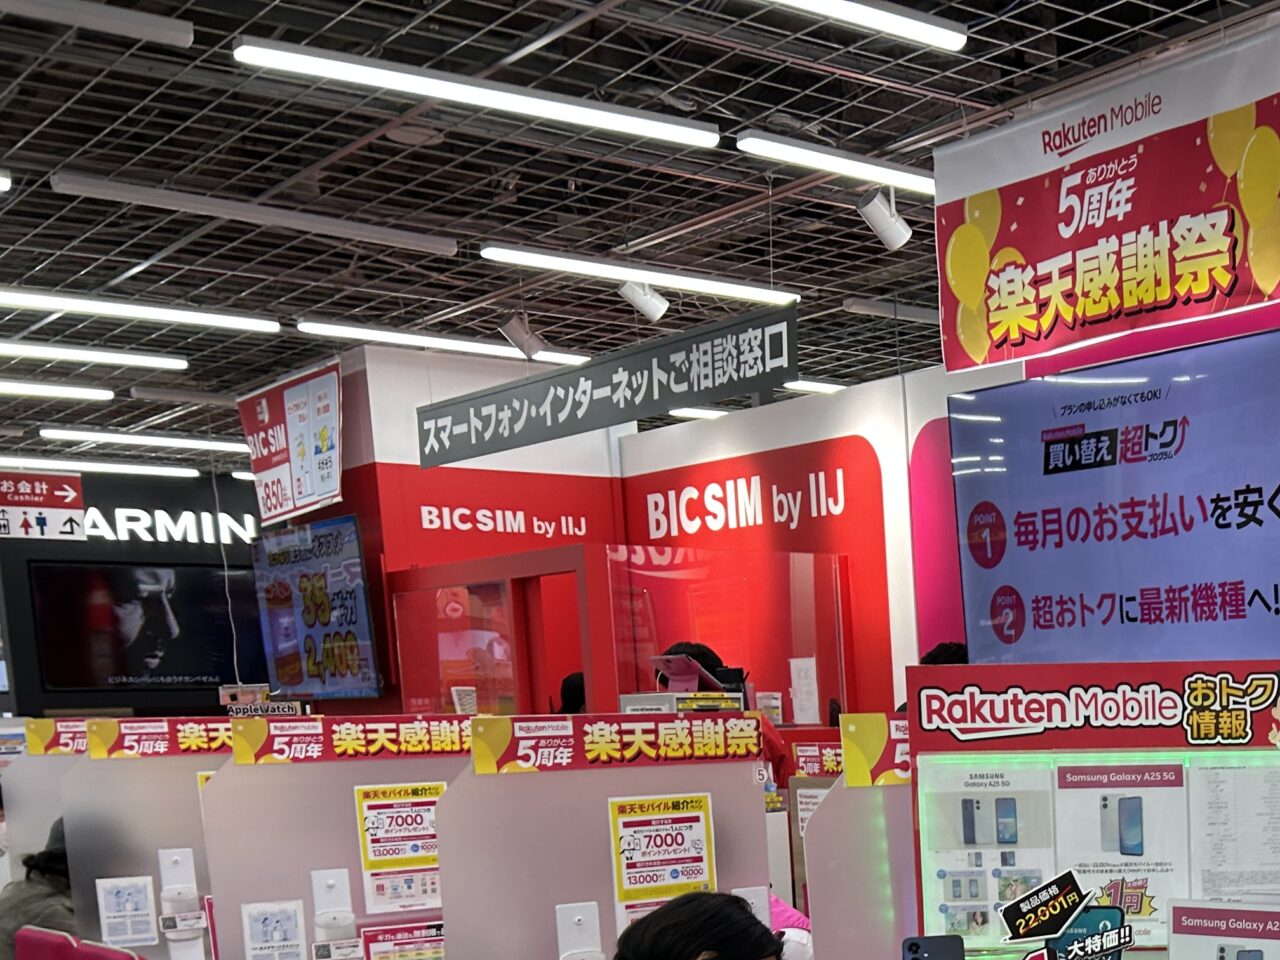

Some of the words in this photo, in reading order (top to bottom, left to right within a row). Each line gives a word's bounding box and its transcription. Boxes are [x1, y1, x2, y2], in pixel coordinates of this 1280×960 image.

[1042, 113, 1107, 157] Rakuten
[1110, 93, 1163, 132] Mobile
[1085, 155, 1138, 184] ありがとう
[1057, 170, 1137, 239] 5周年
[987, 210, 1234, 342] 楽天感謝祭
[423, 320, 790, 456] スマートフォン・インターネットご相談窓口
[1048, 434, 1114, 470] 買い替え
[0, 480, 48, 495] お会計
[7, 493, 44, 502] Cashier
[772, 484, 802, 529] by
[809, 468, 846, 518] IIJ
[533, 516, 557, 538] by
[561, 516, 587, 536] IIJ
[973, 513, 997, 525] POINT
[981, 529, 993, 559] 1
[1031, 580, 1280, 631] 超おトクに最新機種へ!
[1001, 607, 1016, 636] 2
[1187, 675, 1276, 708] おトク
[925, 686, 1067, 738] Rakuten
[1074, 684, 1181, 727] Mobile
[1187, 709, 1250, 742] 情報
[332, 720, 472, 756] 楽天感謝
[518, 723, 545, 736] Rakuten
[583, 718, 760, 761] 楽天感謝祭
[123, 735, 169, 755] 5周年
[272, 736, 323, 760] 5周年
[517, 739, 574, 768] 5周年
[964, 781, 988, 789] Galaxy
[1066, 773, 1108, 783] Samsung
[1110, 773, 1142, 782] Galaxy
[1143, 772, 1161, 781] A25
[1163, 772, 1176, 780] 5G
[1019, 884, 1060, 913] 製品価格
[1181, 915, 1225, 932] Samsung
[1228, 918, 1264, 933] Galaxy
[1068, 926, 1130, 960] 大特価!!
